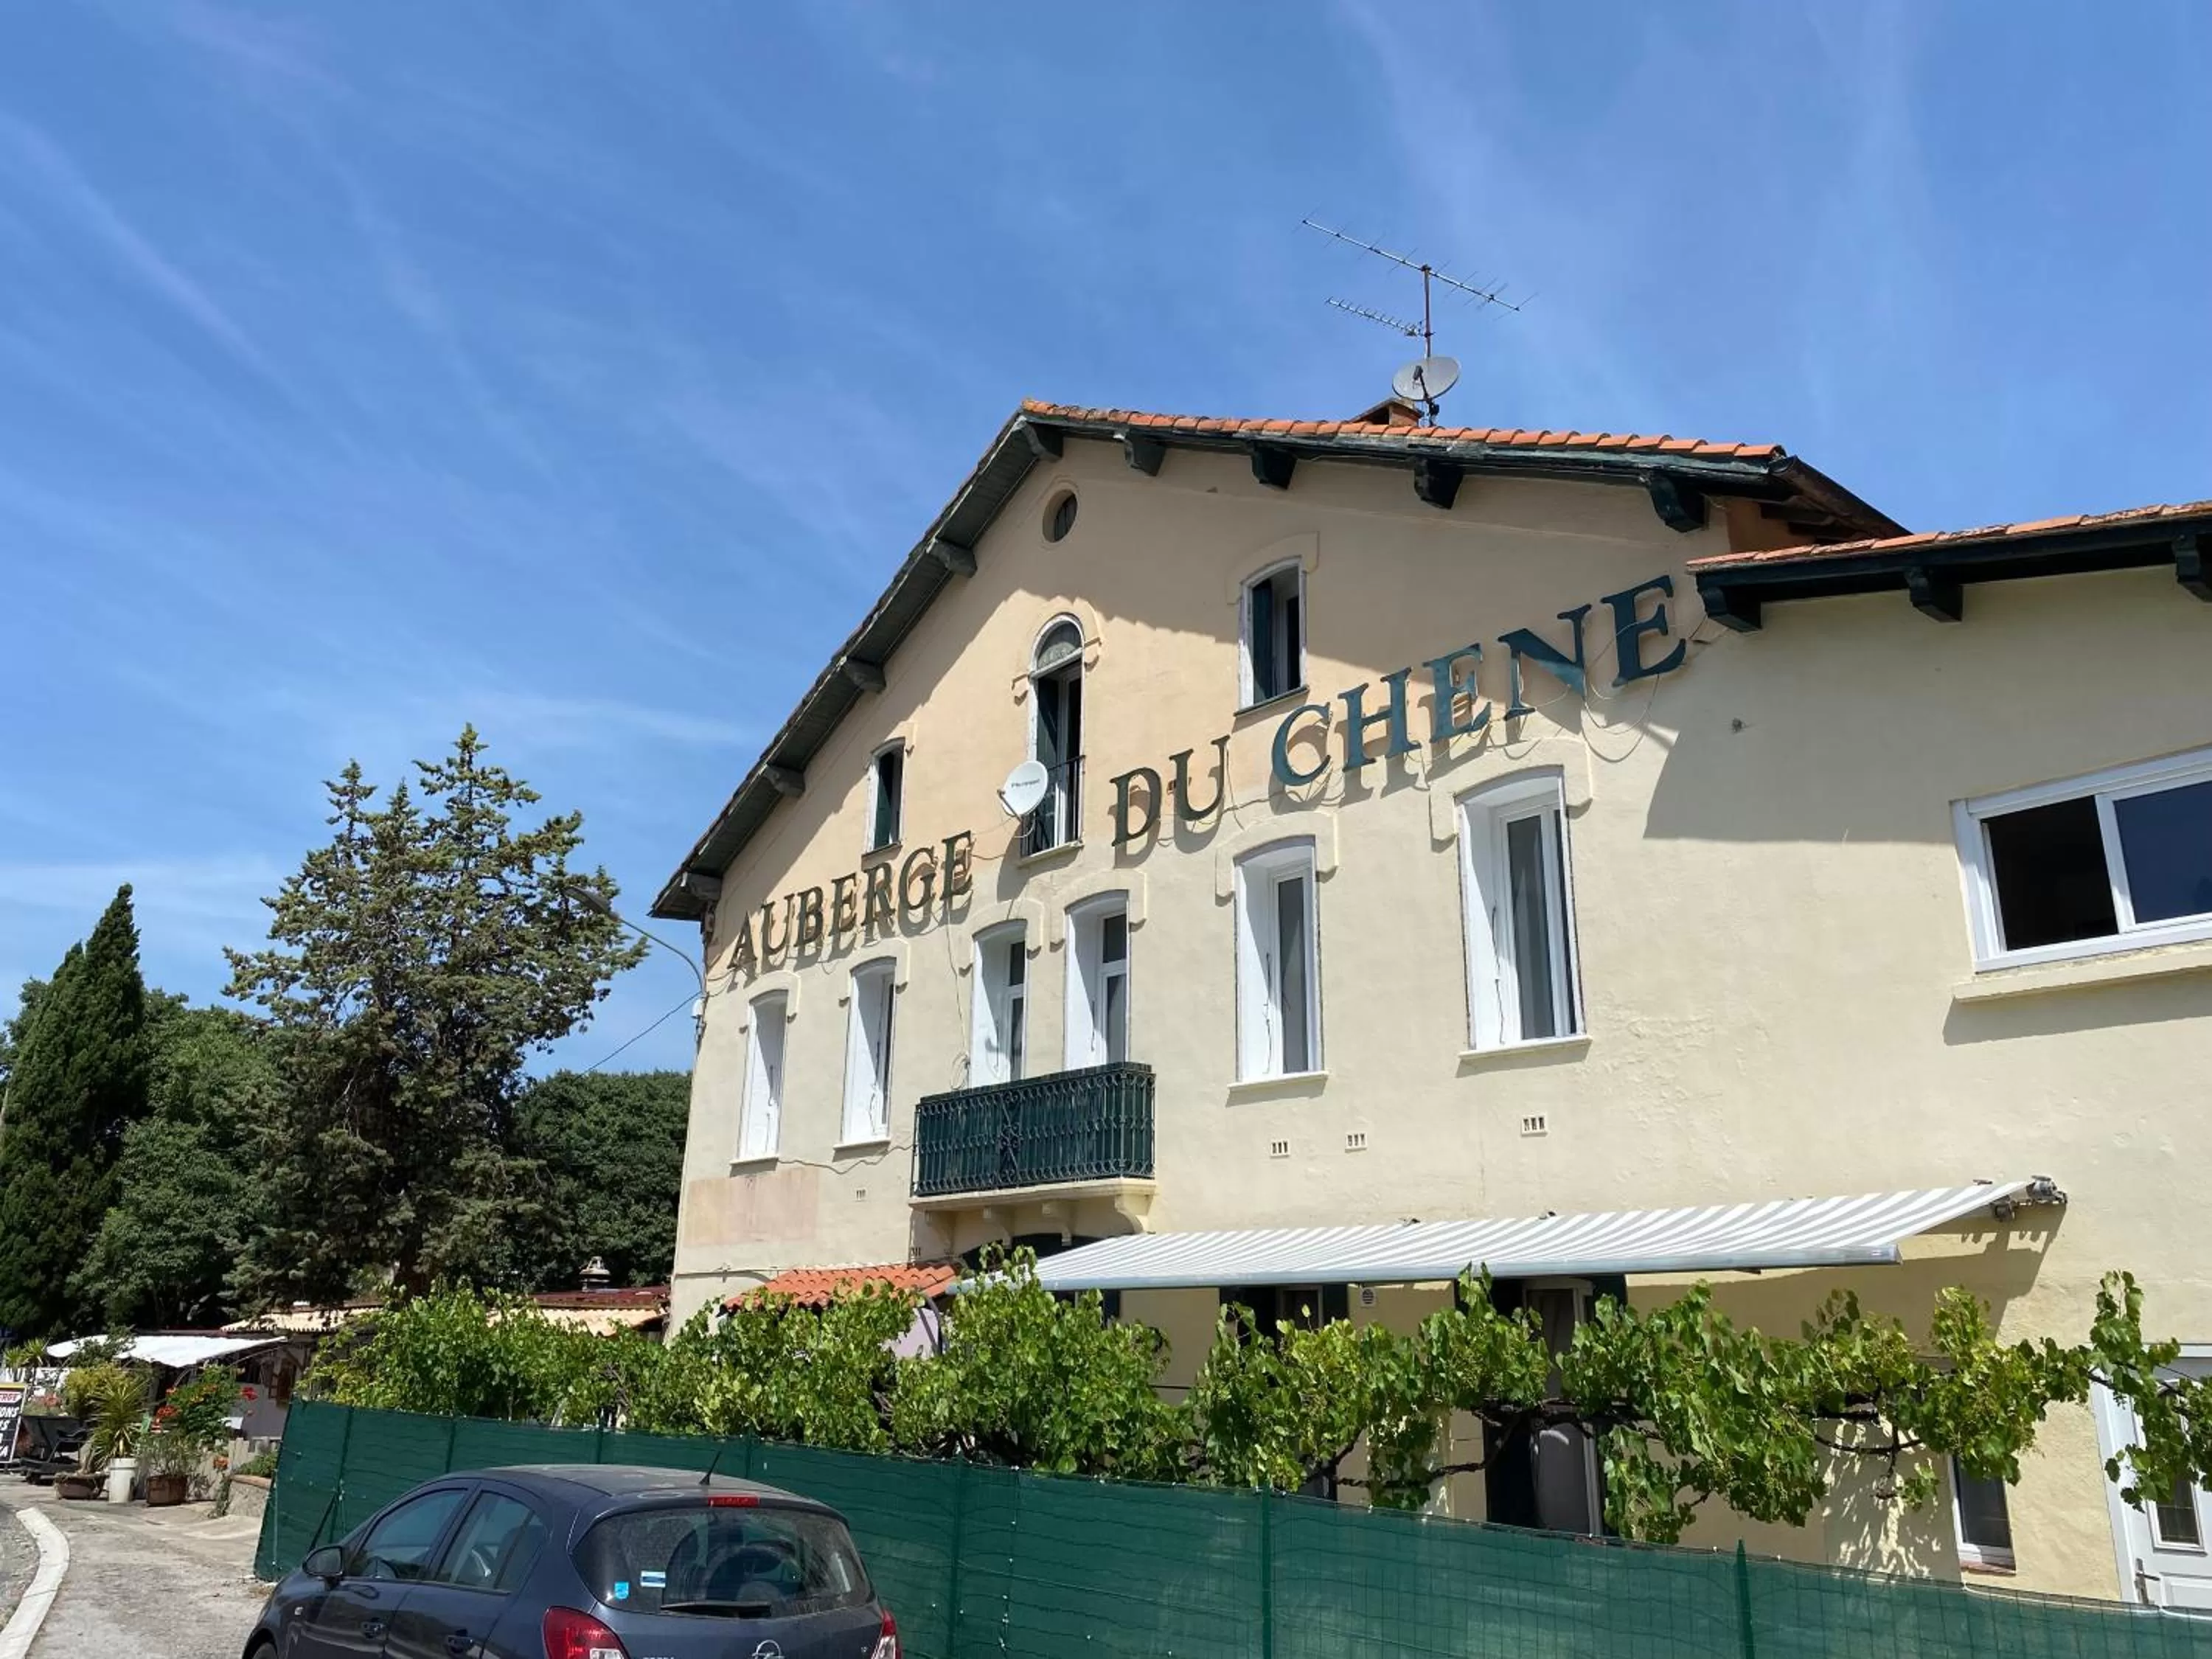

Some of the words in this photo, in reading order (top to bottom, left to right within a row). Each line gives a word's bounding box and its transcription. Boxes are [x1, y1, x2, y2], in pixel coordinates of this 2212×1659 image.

[726, 830, 974, 970] AUBERGE
[1110, 734, 1231, 847] DU
[1271, 574, 1687, 787] CHENE
